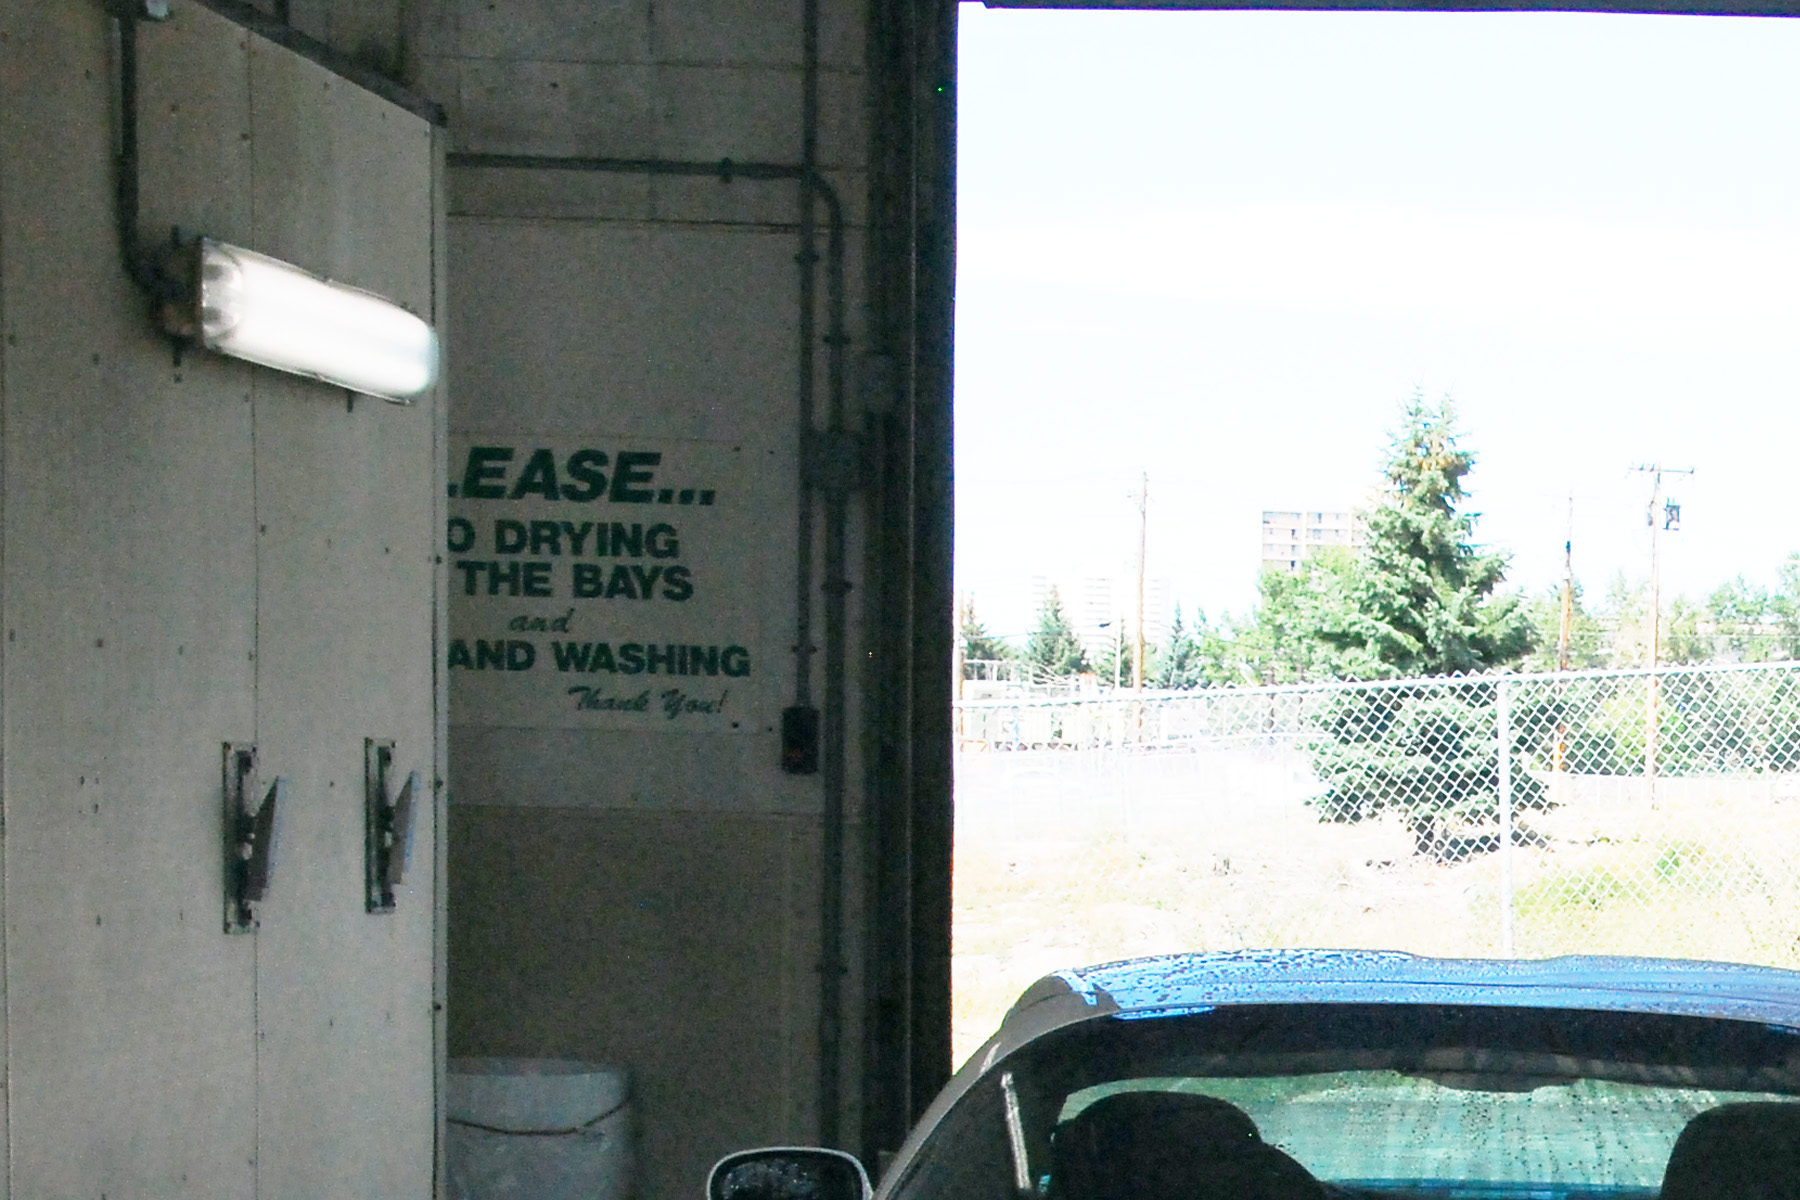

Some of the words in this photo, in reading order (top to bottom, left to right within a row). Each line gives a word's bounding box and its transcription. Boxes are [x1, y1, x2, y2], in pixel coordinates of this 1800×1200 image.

[494, 519, 680, 559] DRYING
[456, 560, 552, 597] THE
[573, 564, 694, 601] BAYS
[508, 607, 575, 633] and
[551, 641, 751, 677] WASHING
[567, 685, 650, 712] Thank
[661, 688, 729, 719] You!
